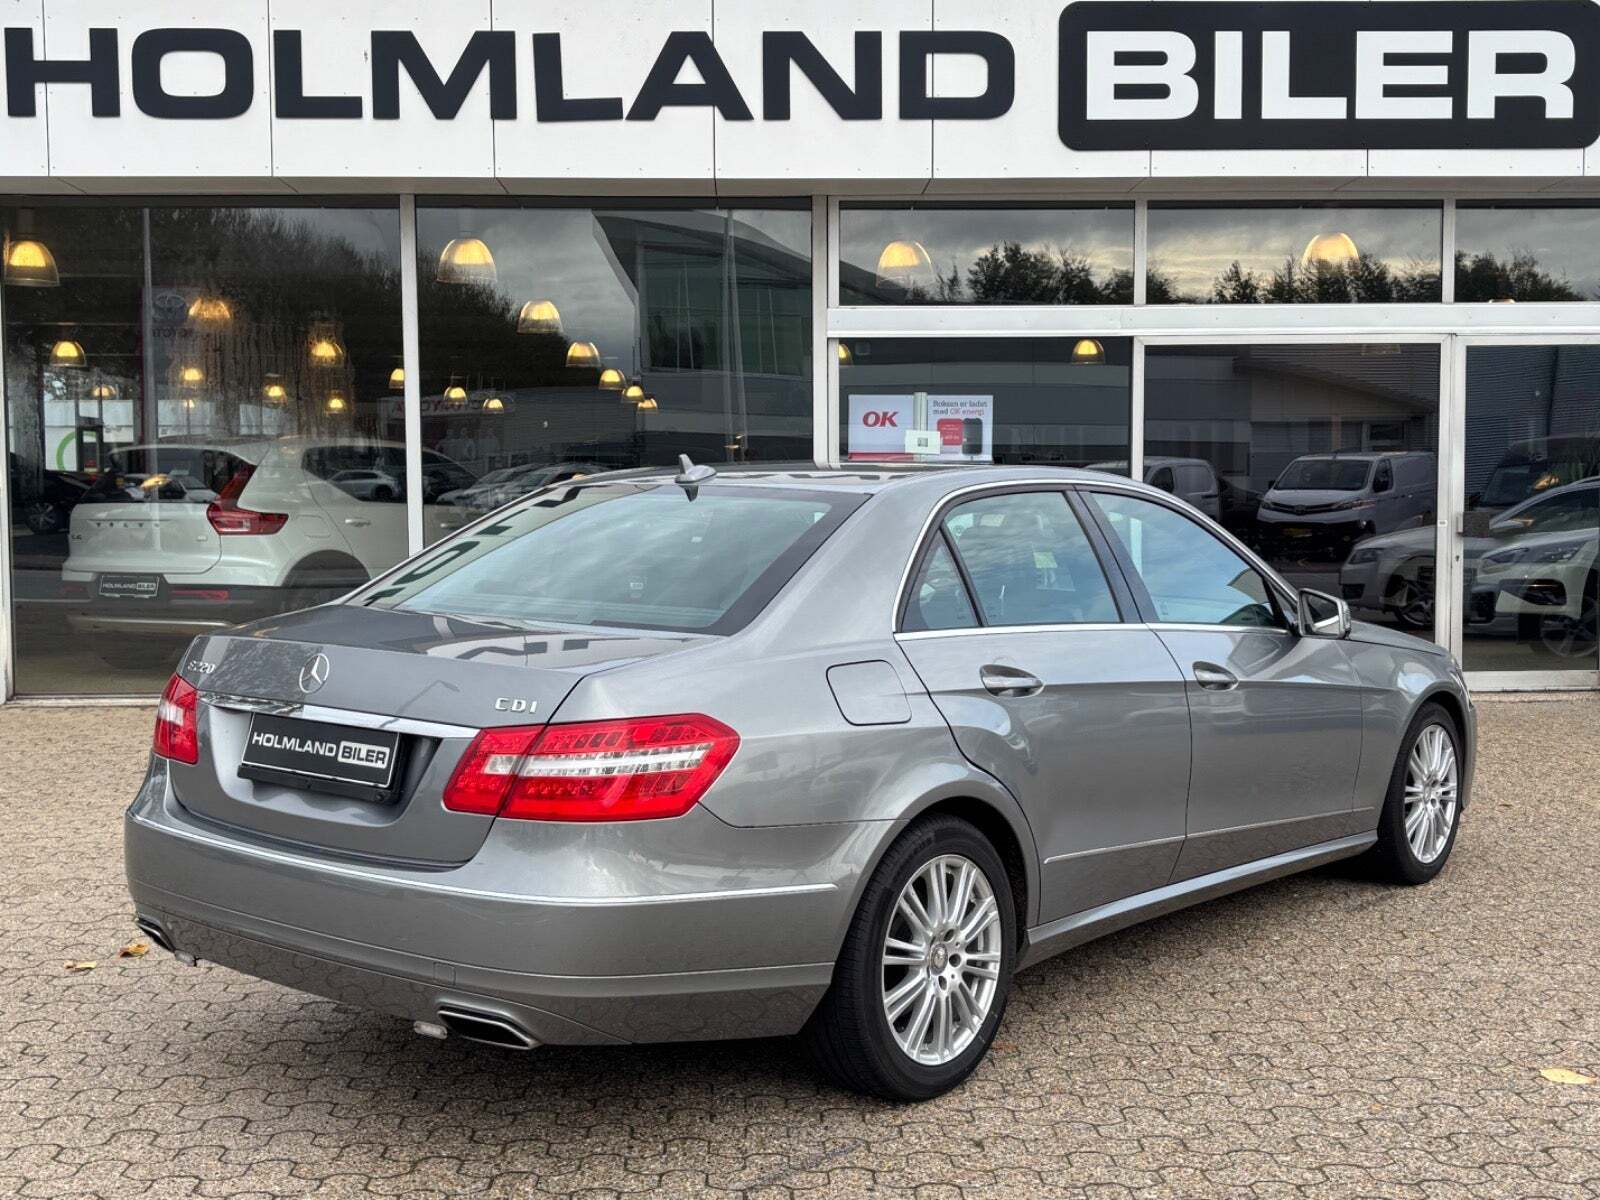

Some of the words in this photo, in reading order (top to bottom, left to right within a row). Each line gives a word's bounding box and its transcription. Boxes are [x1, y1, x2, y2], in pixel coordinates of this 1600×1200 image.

[4, 27, 1015, 122] HOLMLAND
[1086, 30, 1577, 120] BILER
[863, 411, 898, 427] OK
[495, 697, 537, 712] CDI
[251, 731, 336, 757] HOLMLAND
[341, 745, 387, 765] BILER
